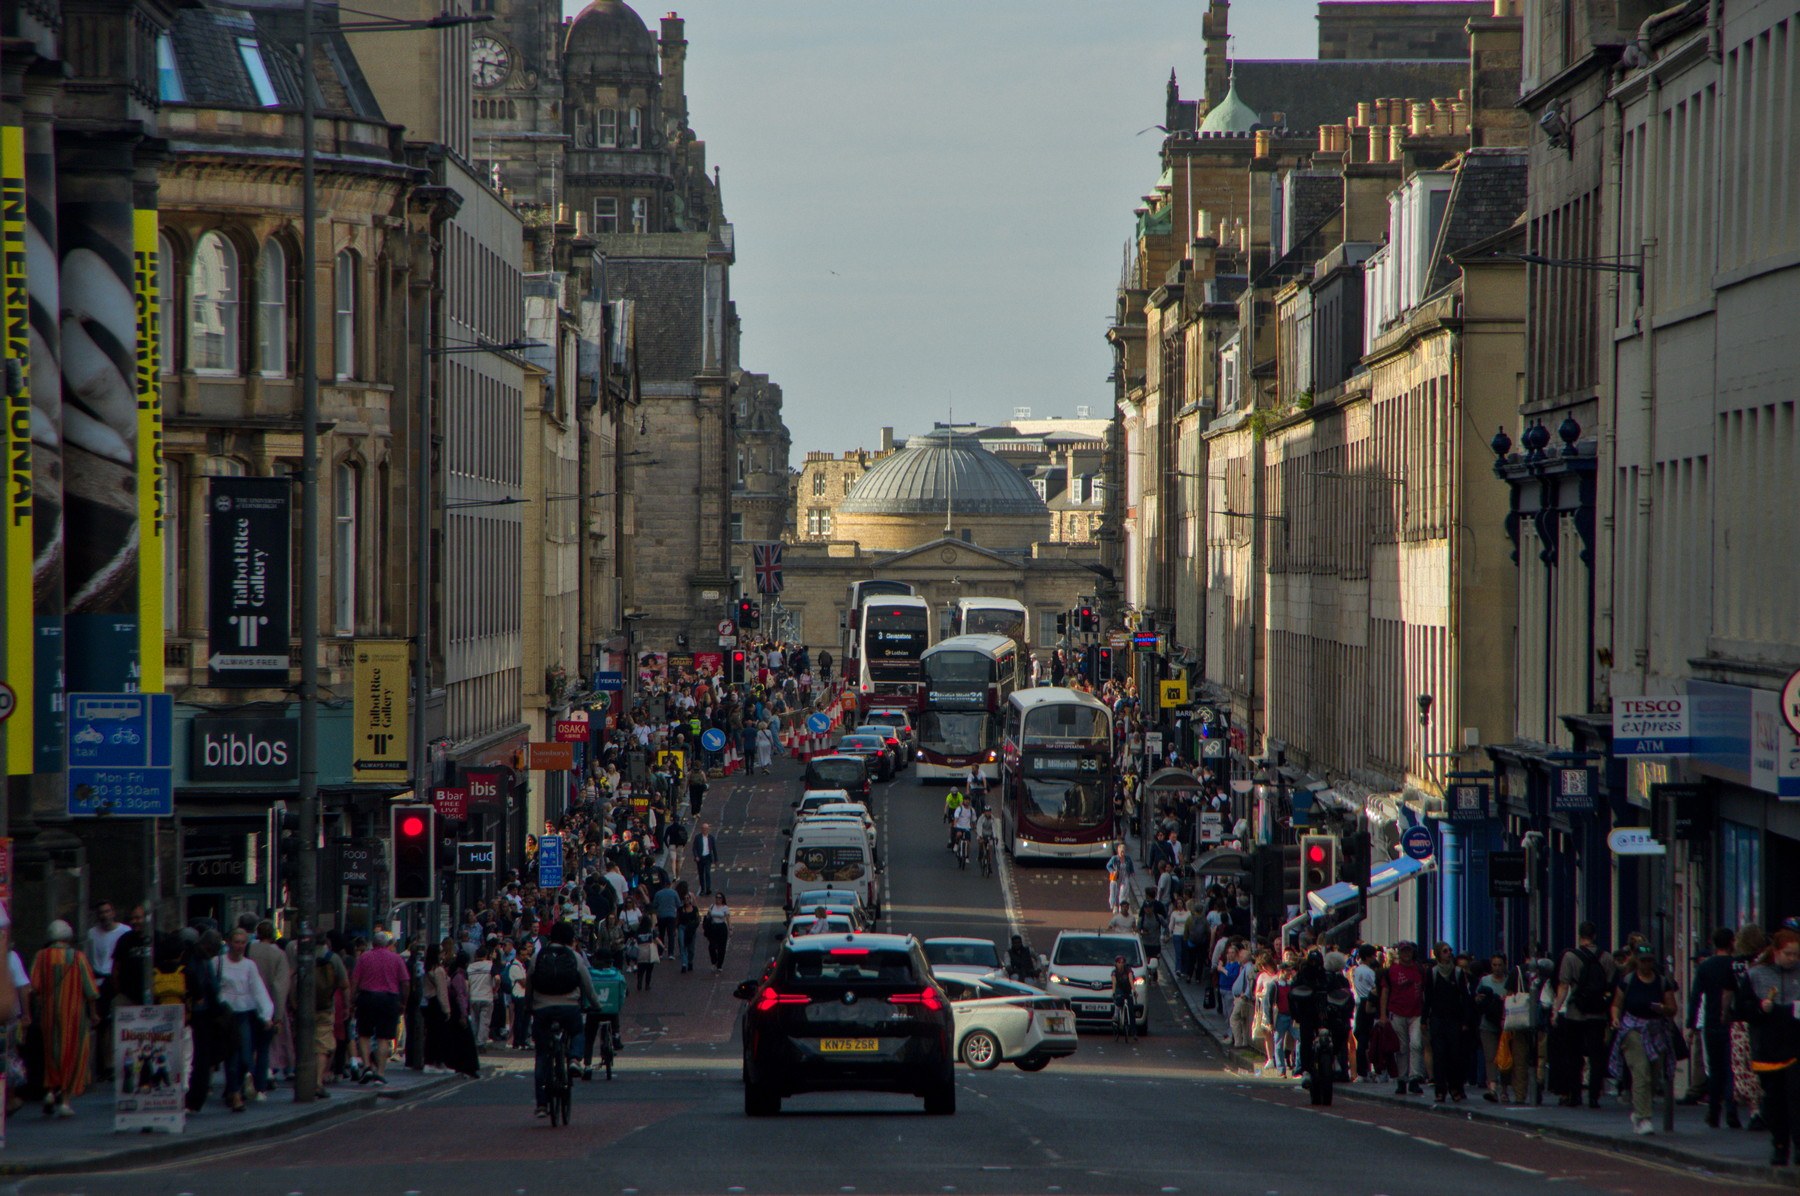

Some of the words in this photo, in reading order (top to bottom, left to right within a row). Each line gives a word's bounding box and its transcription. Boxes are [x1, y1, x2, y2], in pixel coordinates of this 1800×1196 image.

[4, 177, 31, 527] INTERNAIONAL
[232, 517, 249, 551] Rice
[232, 553, 249, 609] Talbot
[251, 548, 269, 608] Gallery
[219, 658, 254, 667] ALWAYS
[256, 658, 278, 667] FREE
[370, 668, 382, 692] Rice
[370, 695, 382, 731] Talbot
[382, 687, 394, 729] Gallery
[1621, 700, 1682, 713] TESCO
[558, 724, 587, 734] OSAKA
[1621, 721, 1682, 736] express
[75, 748, 98, 757] taxi
[203, 733, 289, 767] biblos
[1636, 740, 1664, 753] ATM
[1081, 760, 1097, 770] 33
[96, 772, 145, 783] Mon-Fri
[470, 781, 497, 796] ibis
[436, 791, 446, 800] B
[447, 791, 464, 801] bar
[343, 851, 368, 860] FOOD
[352, 863, 359, 871] &
[343, 872, 368, 881] DRINK
[825, 1040, 852, 1050] KN75
[855, 1040, 875, 1050] ZSR
